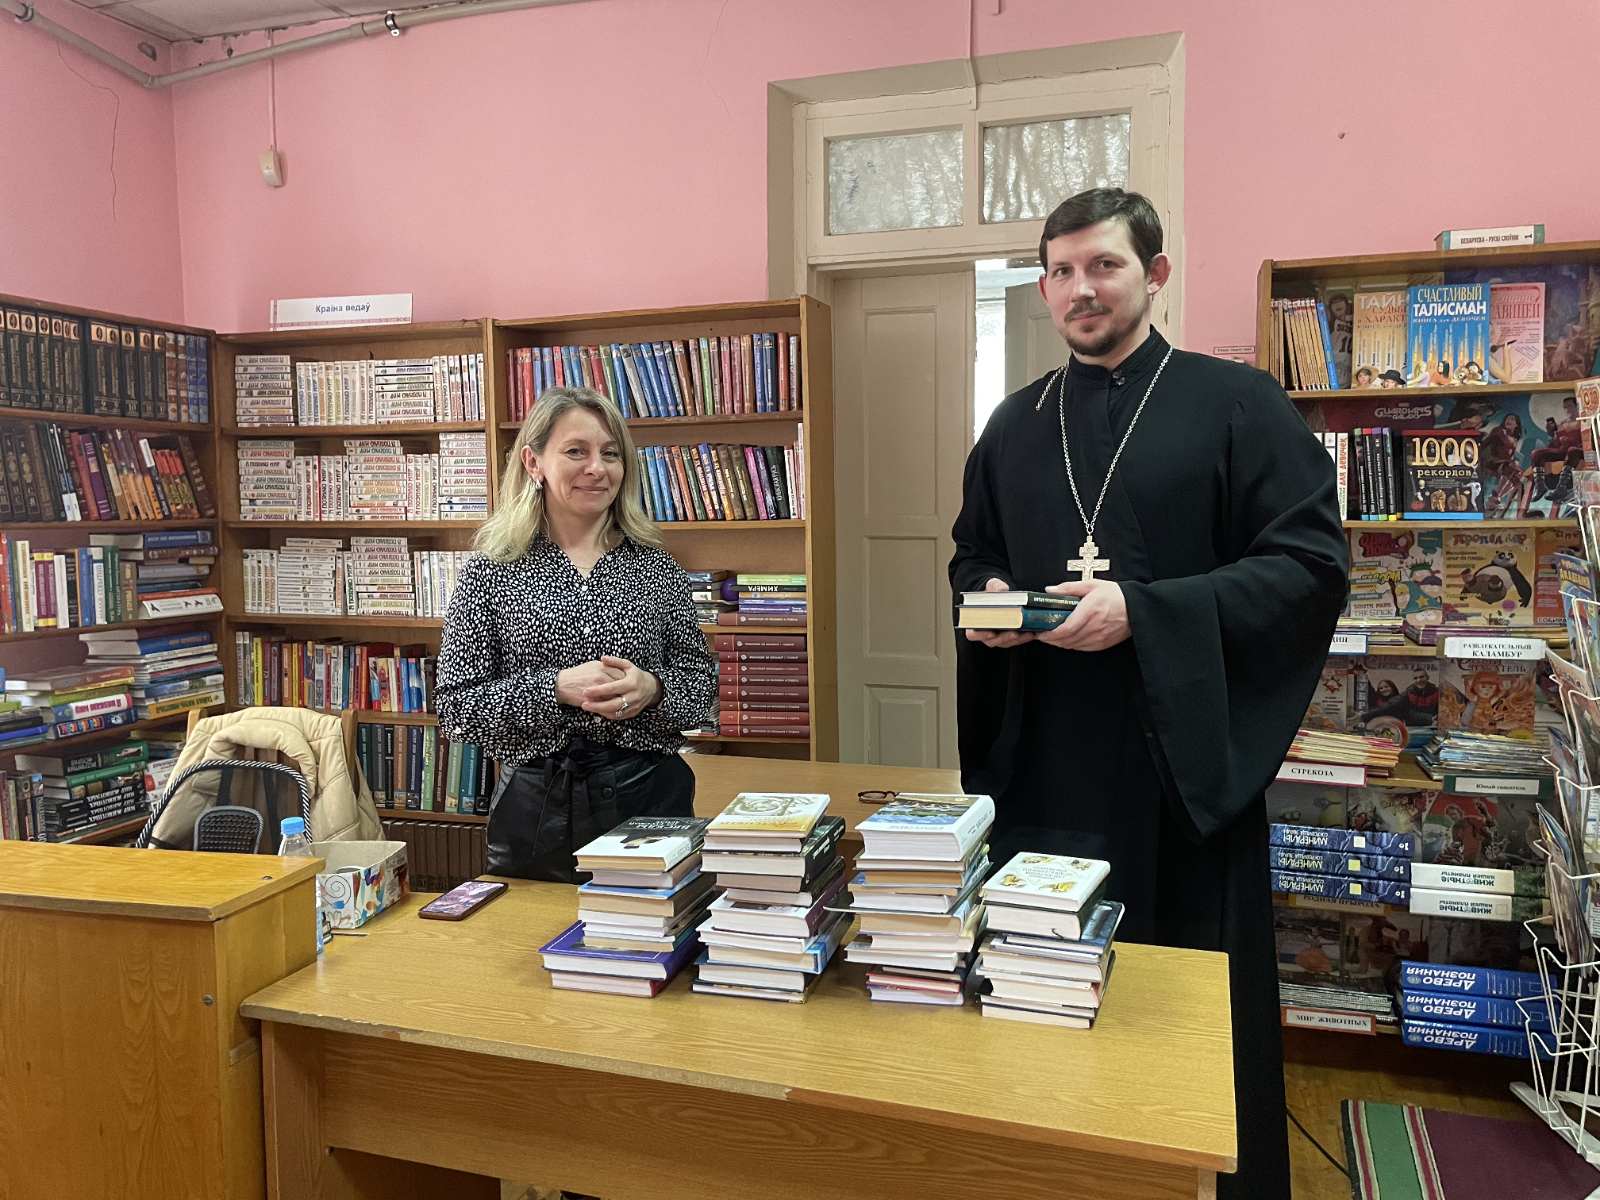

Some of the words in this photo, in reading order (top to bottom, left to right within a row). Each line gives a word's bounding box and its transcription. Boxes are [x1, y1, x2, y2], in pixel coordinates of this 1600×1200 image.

[1417, 283, 1482, 303] СЧАСТЛИВЫЙ
[1359, 293, 1408, 309] ТАЙН
[316, 304, 343, 314] Краіна
[346, 302, 371, 312] ведаў
[1413, 301, 1487, 317] ТАЛИСМАН
[1412, 436, 1480, 468] 1000
[1417, 468, 1473, 478] рекордов
[1472, 650, 1522, 658] КАЛАМБУР
[1283, 834, 1328, 846] МИНЕРАЛЫ
[1278, 857, 1323, 870] МИНЕРАЛЫ
[1278, 880, 1324, 892] МИНЕРАЛЫ
[1406, 967, 1476, 979] ПОЗНАНИЯ
[1423, 976, 1476, 990] ДРЕВО
[1406, 995, 1476, 1008] ПОЗНАНИЯ
[1423, 1004, 1476, 1019] ДРЕВО
[1296, 1014, 1315, 1022] МИР
[1318, 1016, 1368, 1027] ЖИВОТНЫХ
[1408, 1026, 1478, 1040] ПОЗНАНИЯ
[1424, 1035, 1476, 1049] ДРЕВО
